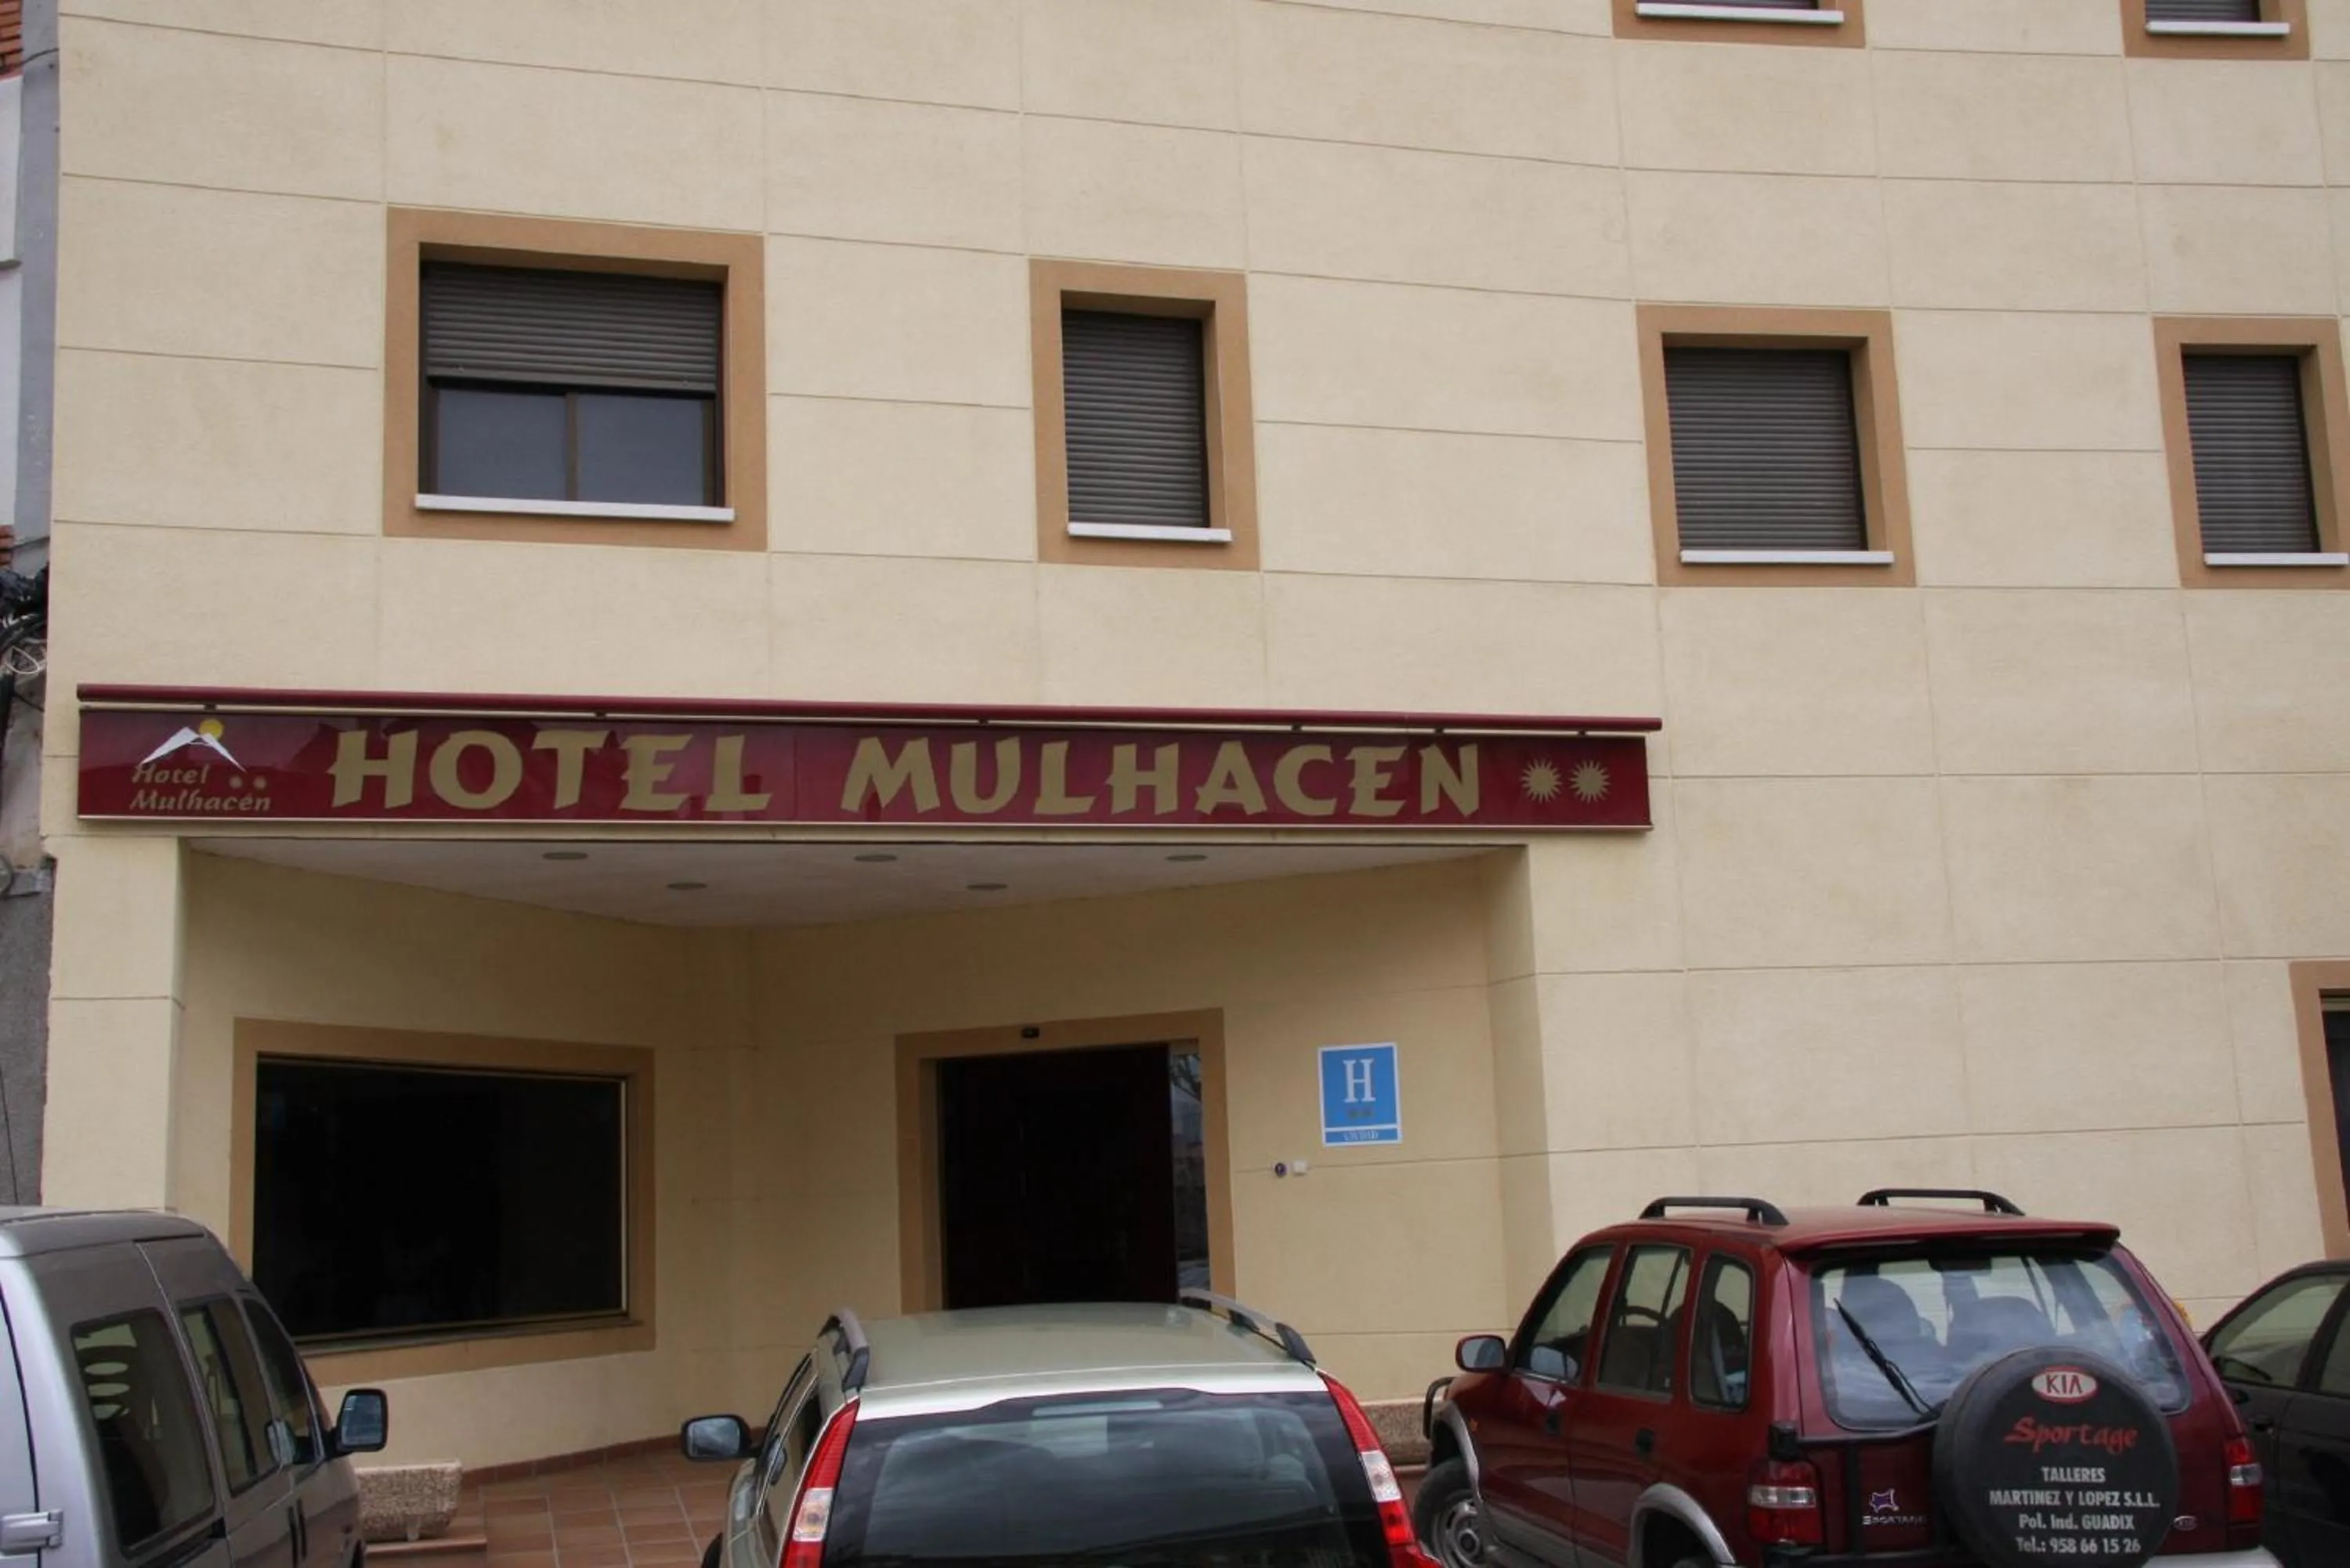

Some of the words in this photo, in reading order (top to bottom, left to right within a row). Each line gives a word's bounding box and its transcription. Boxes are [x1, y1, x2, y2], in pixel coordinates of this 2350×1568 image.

[131, 764, 210, 784] Hotel
[327, 729, 772, 811] HOTEL
[841, 736, 1479, 817] MULHACEN
[1342, 1057, 1377, 1103] H
[2044, 1374, 2084, 1395] KIA
[2003, 1414, 2139, 1455] Sportage
[2041, 1466, 2106, 1483] TALLERES
[1989, 1490, 2061, 1506] MARTINEZ
[2064, 1490, 2074, 1506] Y
[2078, 1490, 2120, 1507] LOPEZ
[2019, 1512, 2047, 1530] Pol.
[2051, 1512, 2078, 1530] Ind.
[2081, 1514, 2135, 1530] GUADIX
[2048, 1537, 2077, 1554] 958
[2080, 1537, 2098, 1554] 66
[2102, 1537, 2120, 1554] 15
[2122, 1537, 2142, 1554] 26
